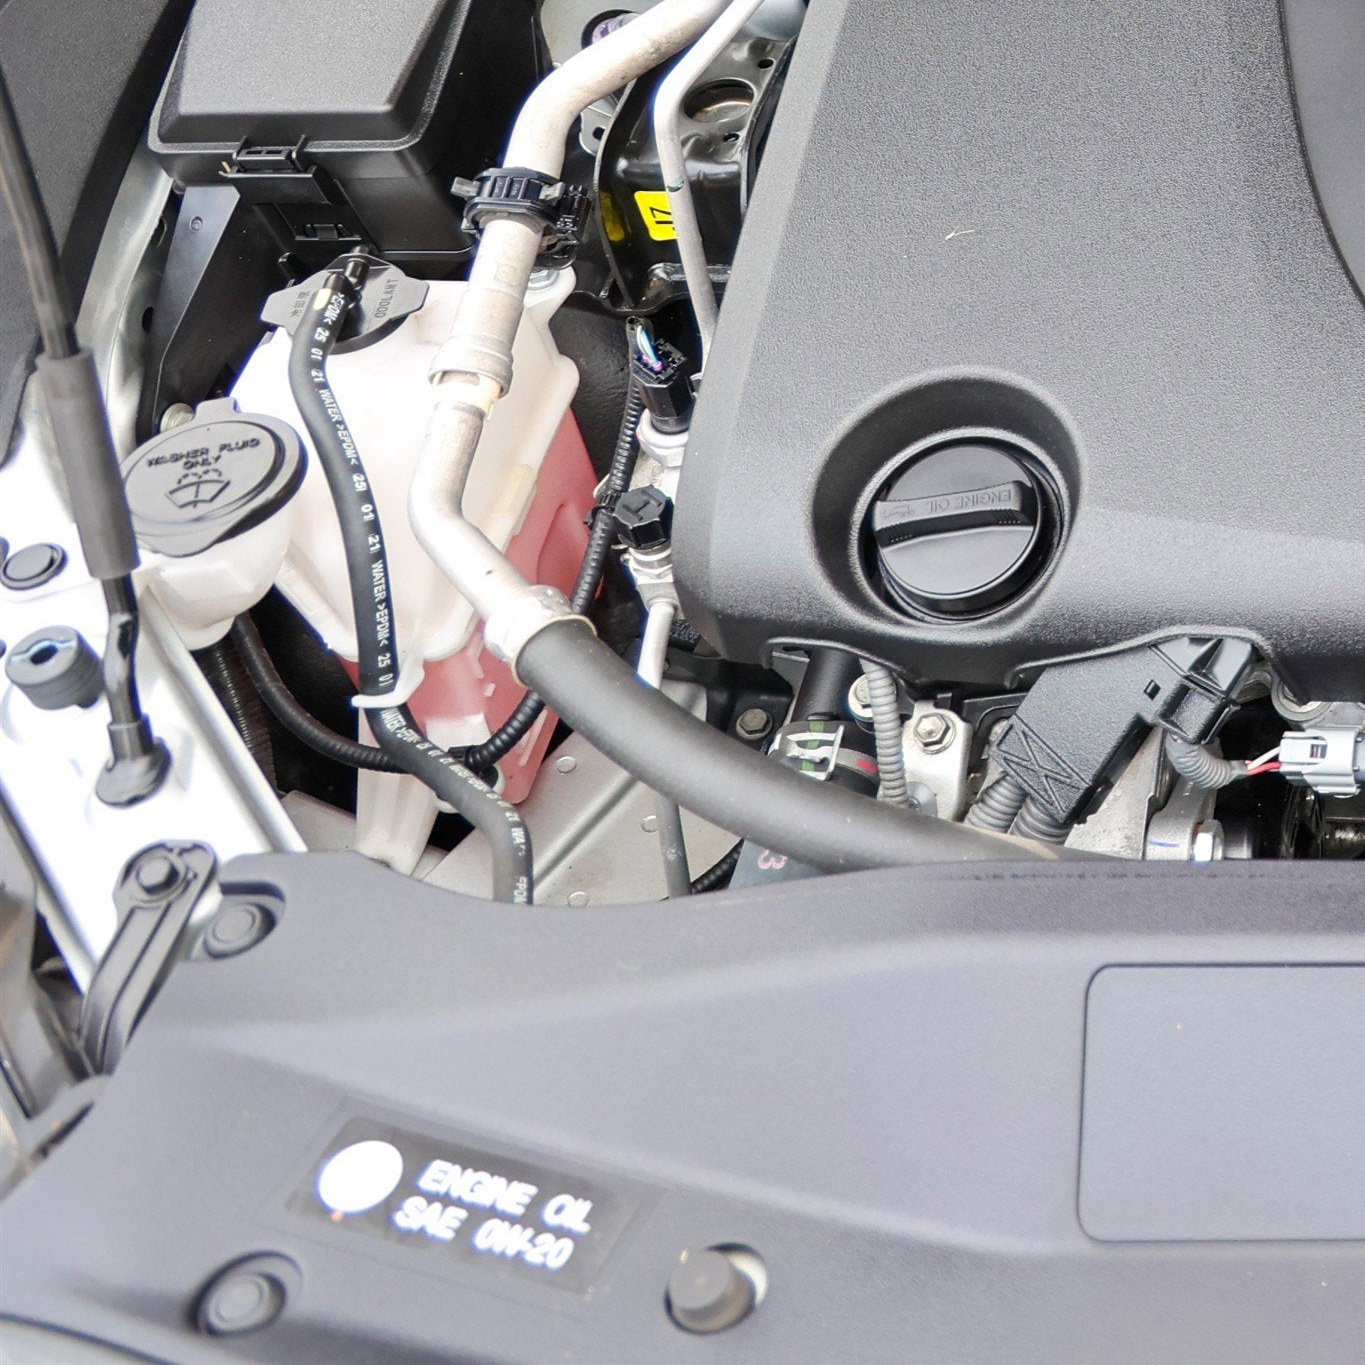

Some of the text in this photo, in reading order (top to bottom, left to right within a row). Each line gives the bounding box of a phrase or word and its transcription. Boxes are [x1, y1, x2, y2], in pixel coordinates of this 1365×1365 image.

[374, 278, 399, 319] COOLANT
[318, 388, 342, 423] WATER
[147, 447, 210, 468] WASHER
[182, 454, 222, 470] ONLY
[955, 488, 1012, 509] ENGINE
[371, 559, 387, 603] WATER
[375, 602, 390, 647] >EPDM<
[377, 652, 391, 669] 25
[416, 1158, 594, 1236] ENGINE OIL
[390, 1195, 575, 1271] SAE 0W-20
